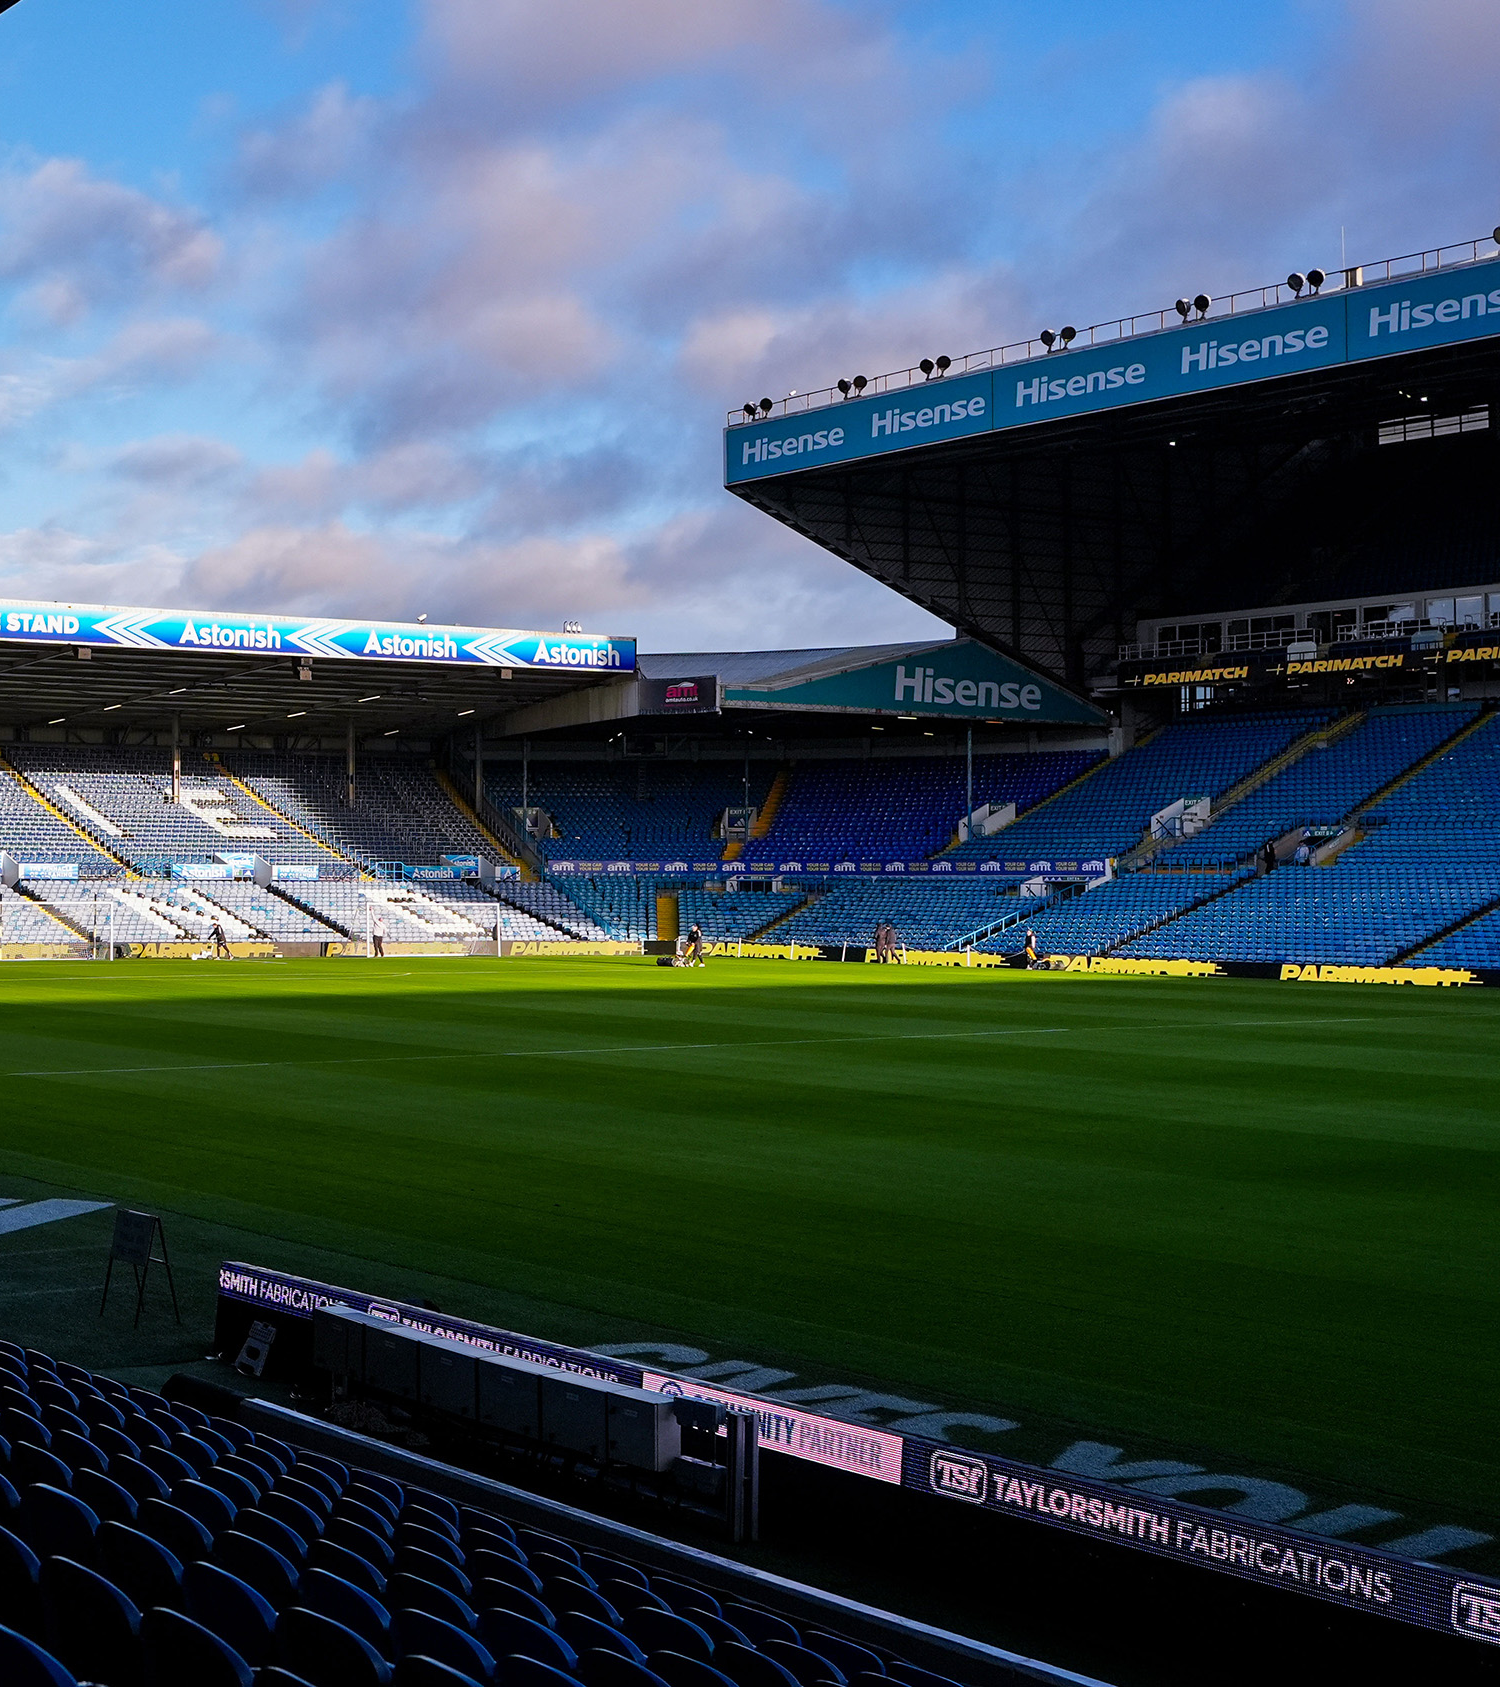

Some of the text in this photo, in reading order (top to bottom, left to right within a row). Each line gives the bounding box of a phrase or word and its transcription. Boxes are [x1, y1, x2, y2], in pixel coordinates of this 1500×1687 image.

[1180, 325, 1329, 375] Hisense
[1015, 363, 1146, 408] Hisense
[871, 396, 986, 438] Hisense
[742, 427, 844, 465] Hisense
[7, 613, 79, 634] STAND
[179, 618, 281, 649] Astonish
[363, 629, 457, 658] Astonish
[533, 639, 620, 667] Astonish
[1446, 646, 1500, 663] PARI
[1286, 654, 1403, 675] PARIMATCH
[1143, 666, 1248, 686] PARIMATCH
[666, 683, 699, 698] amt
[895, 665, 1042, 710] Hisense
[182, 866, 227, 878] Astonish
[412, 867, 454, 878] Astonish
[552, 862, 575, 871] amt
[607, 862, 630, 871] amt
[664, 862, 688, 871] amt
[722, 862, 746, 871] amt
[779, 862, 802, 871] amt
[834, 862, 856, 871] amt
[885, 862, 905, 871] amt
[932, 862, 952, 871] amt
[980, 862, 1001, 871] amt
[1030, 862, 1051, 871] amt
[1081, 862, 1104, 871] amt
[260, 1281, 338, 1311] FABRICATIO
[798, 1422, 883, 1470] PARTNER
[992, 1474, 1170, 1545] TAYLORSMITH
[1176, 1521, 1393, 1603] FABRICATIONS
